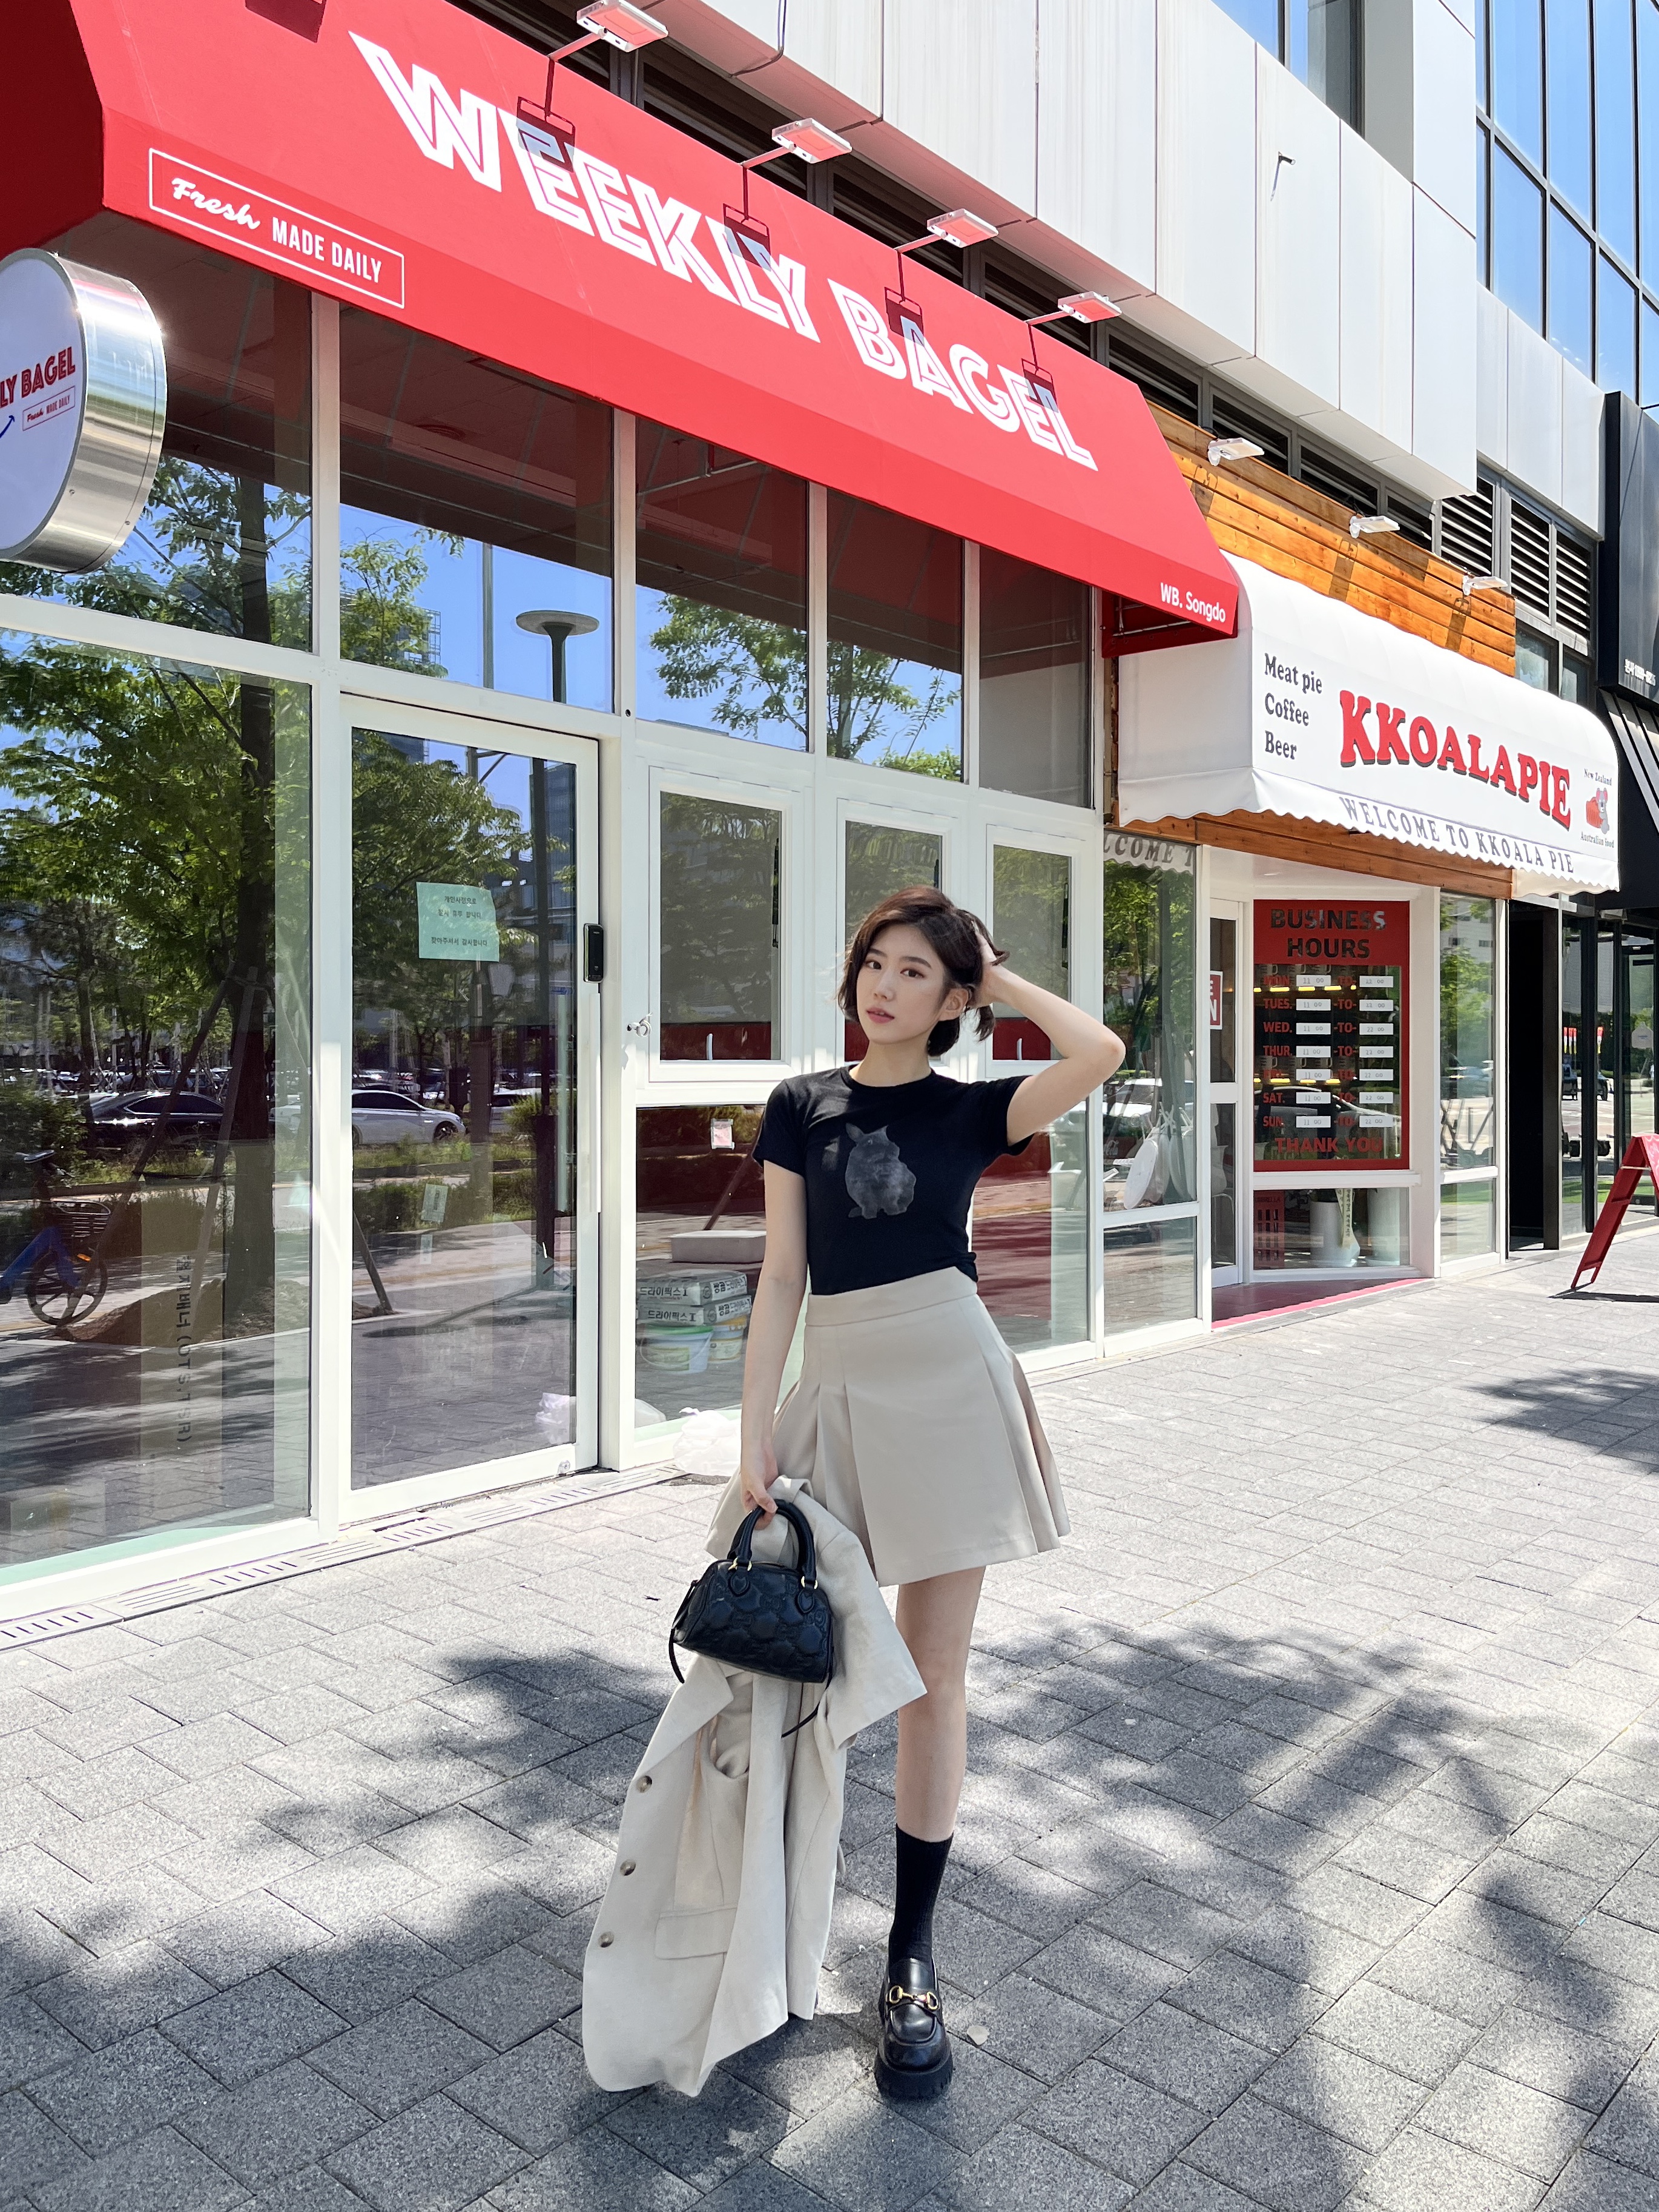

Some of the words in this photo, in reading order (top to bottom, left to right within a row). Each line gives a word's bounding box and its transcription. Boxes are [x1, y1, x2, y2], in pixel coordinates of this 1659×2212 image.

[171, 177, 260, 229] Fresh
[272, 216, 325, 262] MADE
[332, 242, 382, 283] DAILY
[348, 31, 821, 343] WEEKLY
[826, 278, 1099, 472] BAGEL
[21, 346, 76, 399] BAGEL
[1160, 582, 1183, 609] WB.
[1186, 591, 1226, 622] Songdo
[1264, 653, 1299, 685] Meat
[1302, 670, 1322, 694] pie
[1265, 692, 1309, 727] Coffee
[1265, 730, 1297, 760] Beer
[1339, 690, 1571, 831] KKOALAPIE
[1584, 768, 1594, 780] New
[1595, 772, 1612, 786] Zealand
[1339, 796, 1440, 842] WELCOME
[1446, 824, 1469, 850] TO
[1476, 832, 1549, 867] KKOALA
[1548, 850, 1574, 873] PIE
[1580, 831, 1604, 846] Australian
[1271, 908, 1387, 931] BUSINESS
[462, 938, 488, 947] 감사합니다
[1287, 938, 1370, 959] HOURS
[1263, 999, 1293, 1009] TUES.
[1262, 1022, 1293, 1033] WED.
[1263, 1045, 1293, 1057] THUR.
[1263, 1092, 1285, 1103] SAT.
[1275, 1137, 1339, 1154] THANK
[1345, 1137, 1383, 1153] YOU
